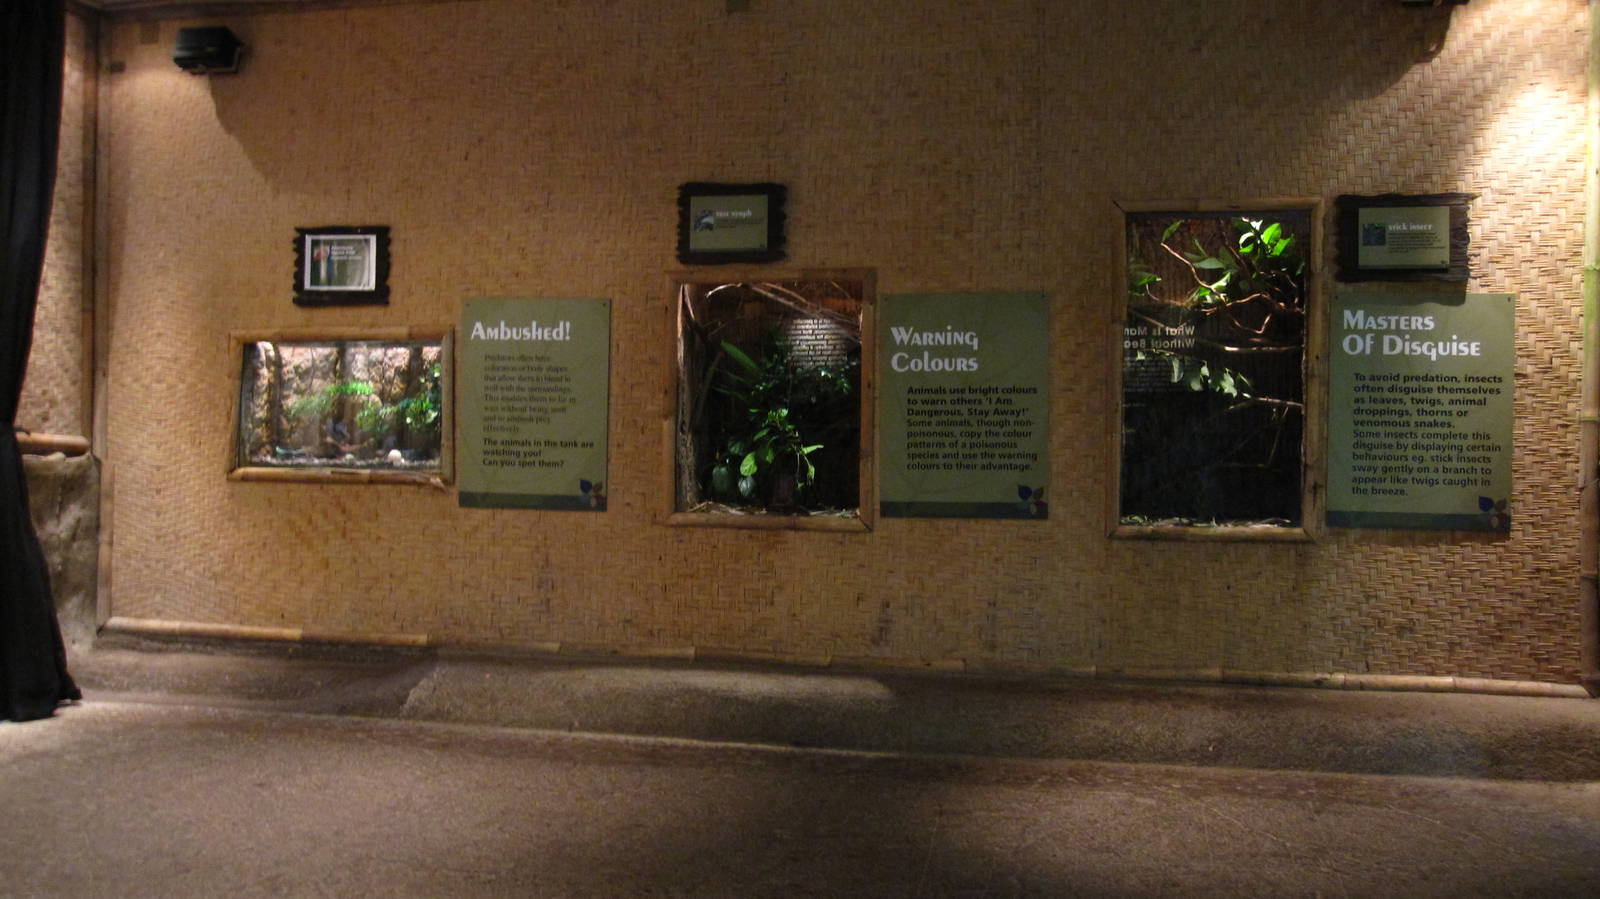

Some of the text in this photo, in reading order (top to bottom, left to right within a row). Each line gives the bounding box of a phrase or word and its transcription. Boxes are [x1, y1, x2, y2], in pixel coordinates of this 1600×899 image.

[1354, 373, 1366, 382] To
[1369, 372, 1400, 382] avoid
[1464, 374, 1503, 384] insects
[907, 386, 946, 395] Animals
[969, 386, 999, 396] bright
[1001, 386, 1038, 394] colours
[1354, 384, 1501, 395] often disguise themselves
[907, 398, 918, 406] to
[921, 398, 946, 406] warn
[950, 398, 982, 406] others
[995, 398, 1013, 406] Am
[1448, 397, 1487, 406] animal
[968, 408, 990, 417] Stay
[1416, 408, 1453, 417] thorns
[976, 419, 1010, 429] though
[1353, 419, 1410, 428] venomous
[960, 430, 982, 439] copy
[985, 430, 1000, 438] the
[1002, 430, 1032, 438] colour
[1353, 430, 1490, 441] Some insects complete this
[483, 438, 498, 446] The
[500, 438, 532, 448] animals
[534, 439, 542, 447] in
[544, 440, 558, 448] the
[560, 440, 578, 448] tank
[907, 440, 946, 450] patterns
[949, 440, 959, 448] of
[970, 440, 1018, 450] poisonous
[1352, 441, 1501, 453] disguise by displaying certain
[483, 448, 521, 458] watching
[907, 451, 1038, 460] species and use the warning
[1352, 452, 1408, 462] behaviours
[1430, 454, 1453, 462] stick
[1456, 454, 1492, 464] insects
[482, 458, 498, 466] Can
[500, 459, 516, 468] you
[518, 460, 536, 468] spot
[907, 462, 940, 470] colours
[944, 462, 952, 470] to
[956, 462, 976, 470] their
[1352, 464, 1378, 473] sway
[1381, 464, 1414, 475] gently
[1442, 465, 1478, 474] branch
[1480, 466, 1492, 475] to
[1352, 476, 1491, 488] appear like twigs caught in
[1352, 486, 1368, 495] the
